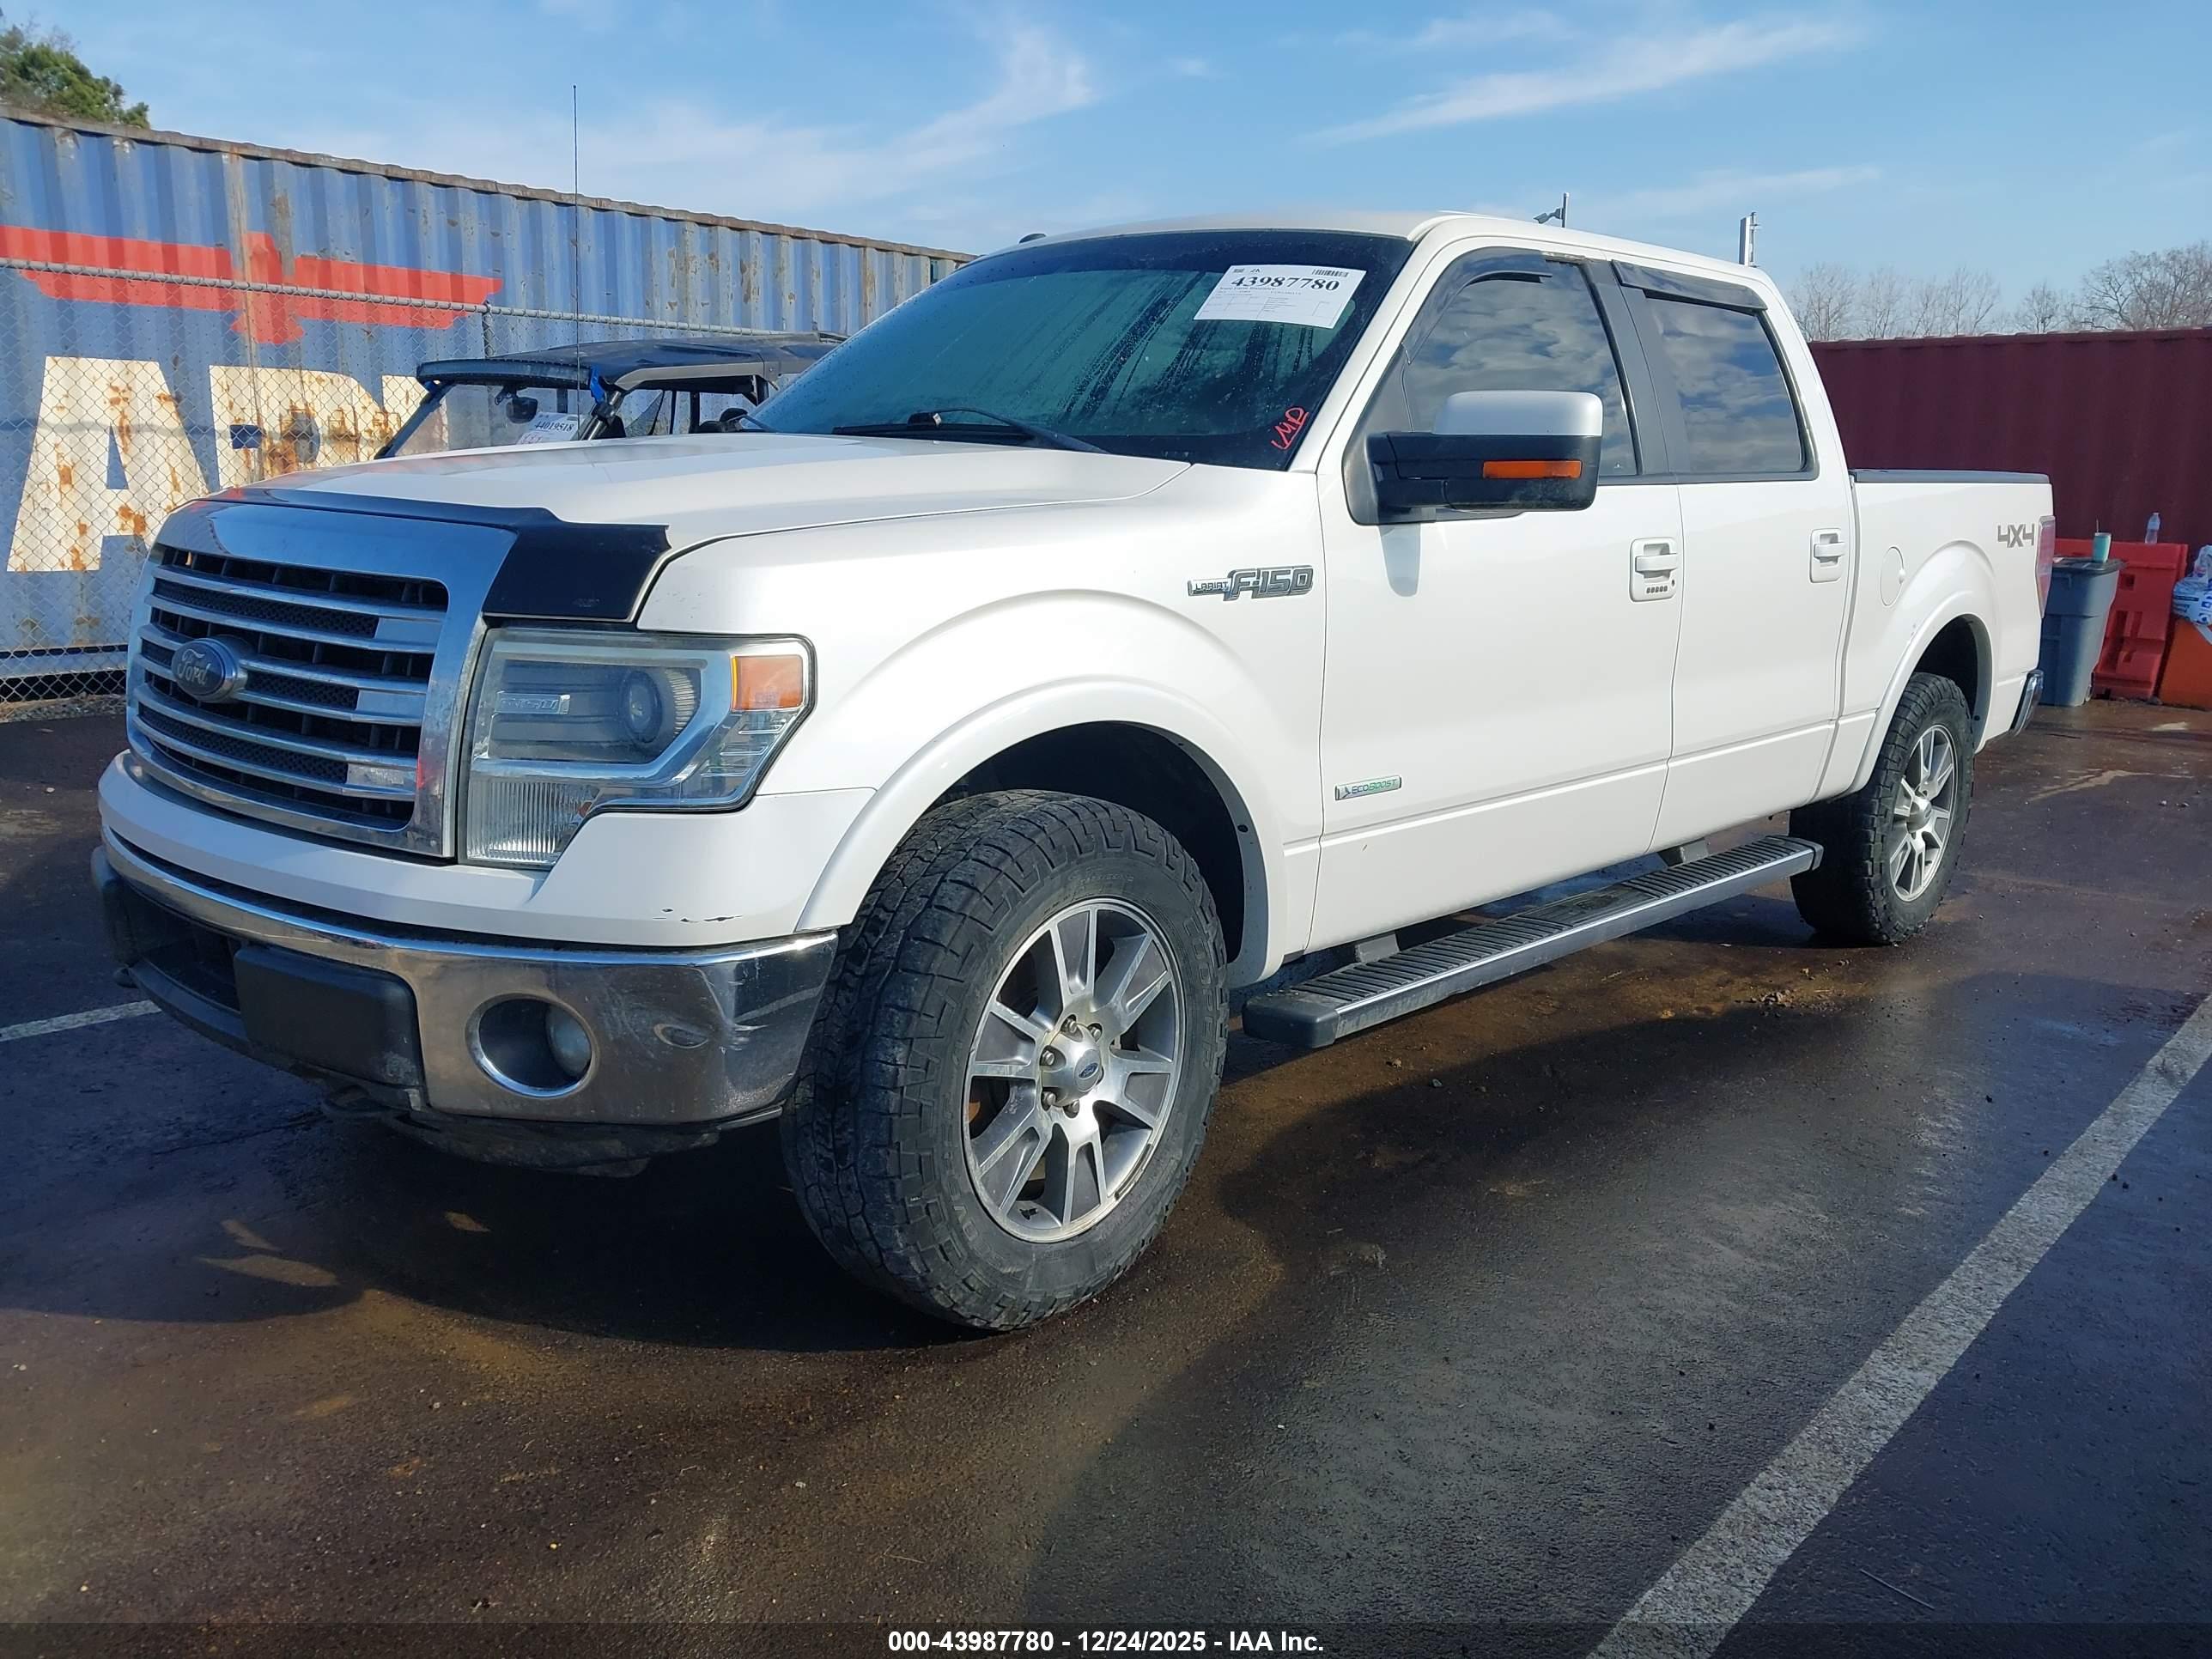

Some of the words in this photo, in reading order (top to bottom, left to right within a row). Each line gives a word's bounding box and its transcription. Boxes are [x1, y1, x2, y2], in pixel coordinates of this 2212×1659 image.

[1231, 276, 1340, 291] 43987780
[1194, 580, 1230, 591] LARIAT
[1224, 565, 1314, 600] F-150
[177, 648, 211, 685] Ford
[1183, 916, 1214, 1067] COOPER
